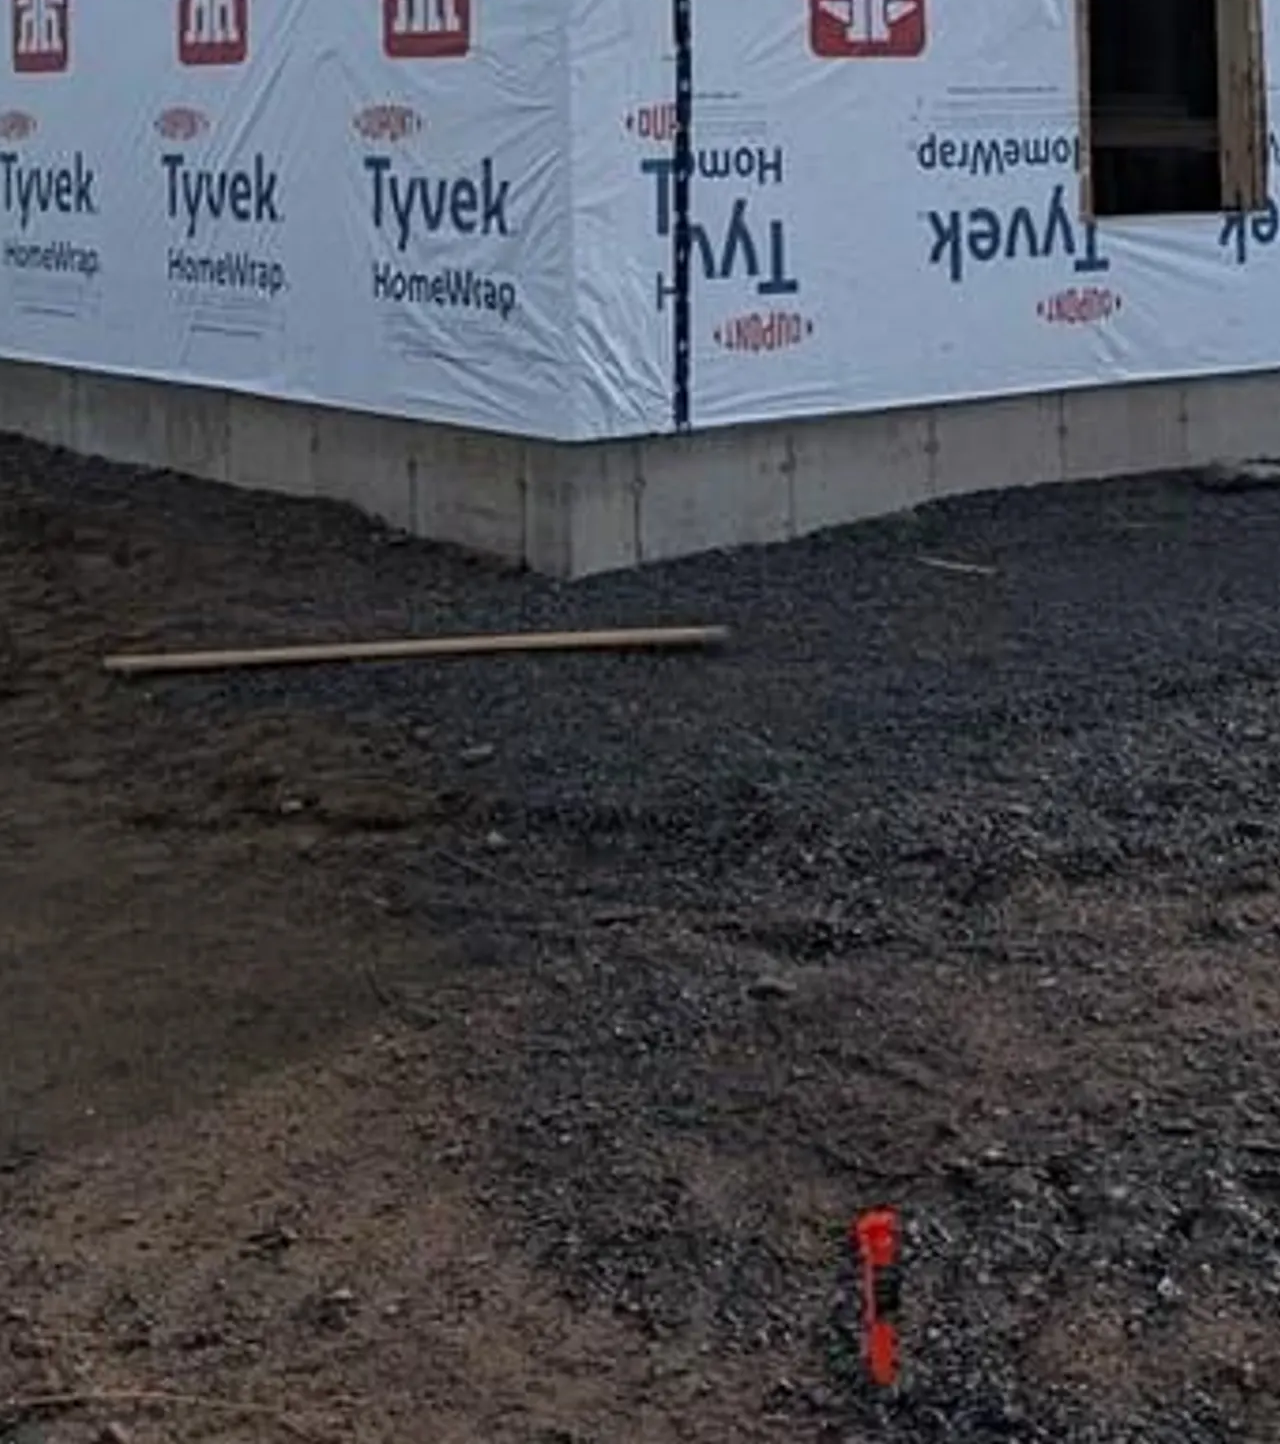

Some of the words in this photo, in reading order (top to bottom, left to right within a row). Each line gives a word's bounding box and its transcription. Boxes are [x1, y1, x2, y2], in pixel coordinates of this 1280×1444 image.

[0, 151, 97, 227] Tyvek
[161, 153, 281, 238] Tyvek
[364, 157, 511, 252] Tyvek
[4, 240, 99, 277] HomeWrap
[928, 184, 1111, 282] Tyvek
[167, 248, 283, 296] HomeWrap
[373, 260, 516, 321] HomeWrap
